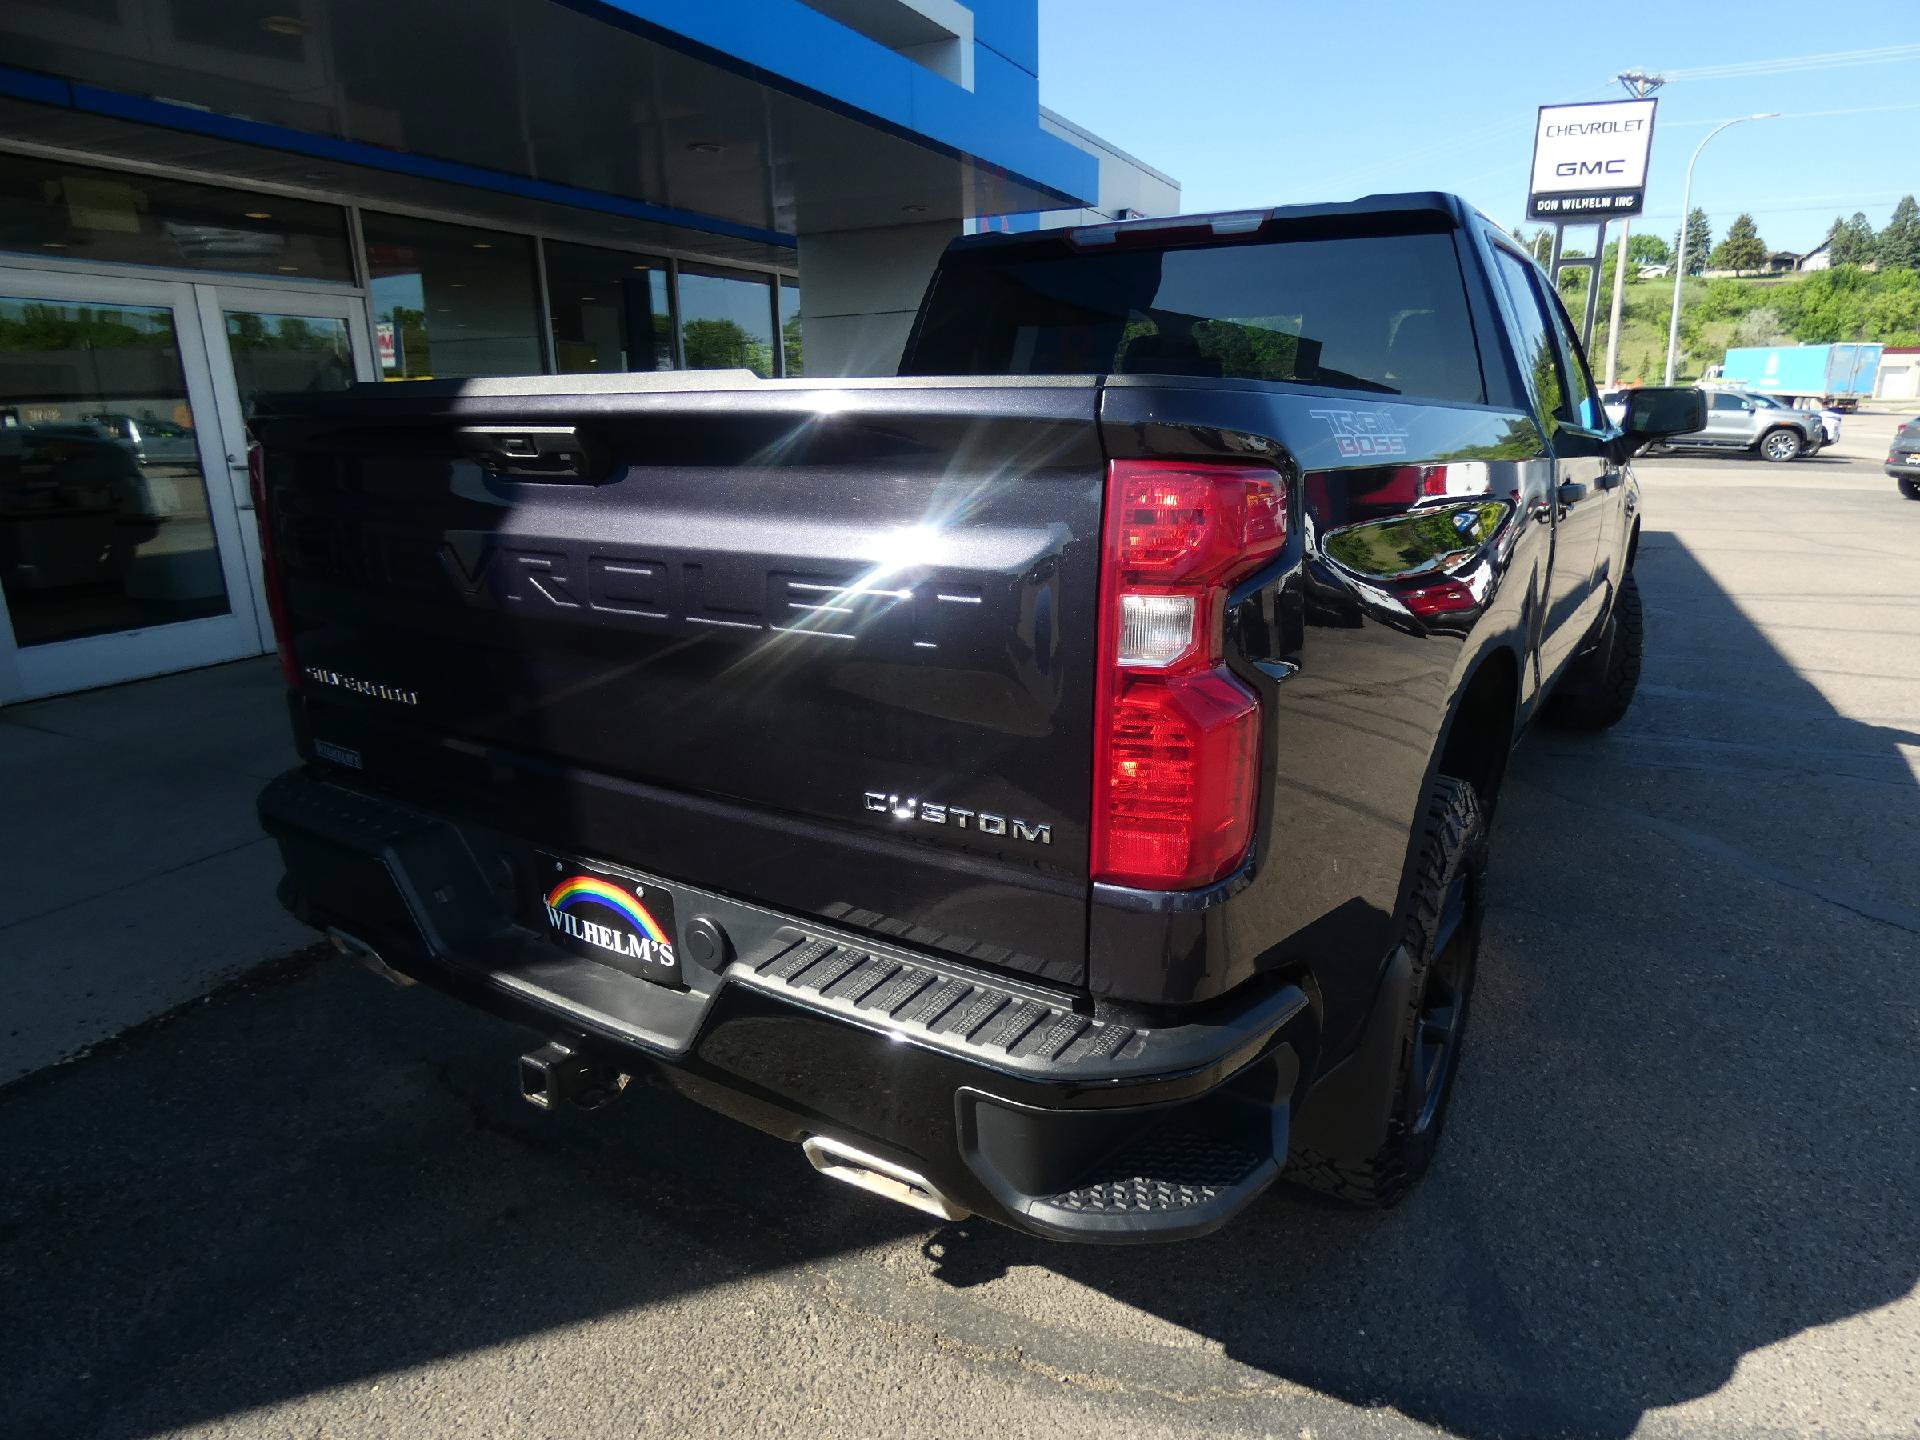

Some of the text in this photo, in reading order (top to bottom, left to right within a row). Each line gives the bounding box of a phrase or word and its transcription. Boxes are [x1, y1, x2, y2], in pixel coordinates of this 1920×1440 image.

[1546, 119, 1644, 137] CHEVROLET
[1556, 159, 1626, 177] GMC
[1537, 196, 1634, 211] DON WILHELM INC
[1338, 435, 1407, 458] BOSS
[863, 792, 1052, 845] CUSTOM
[543, 893, 676, 968] WILHELM'S
